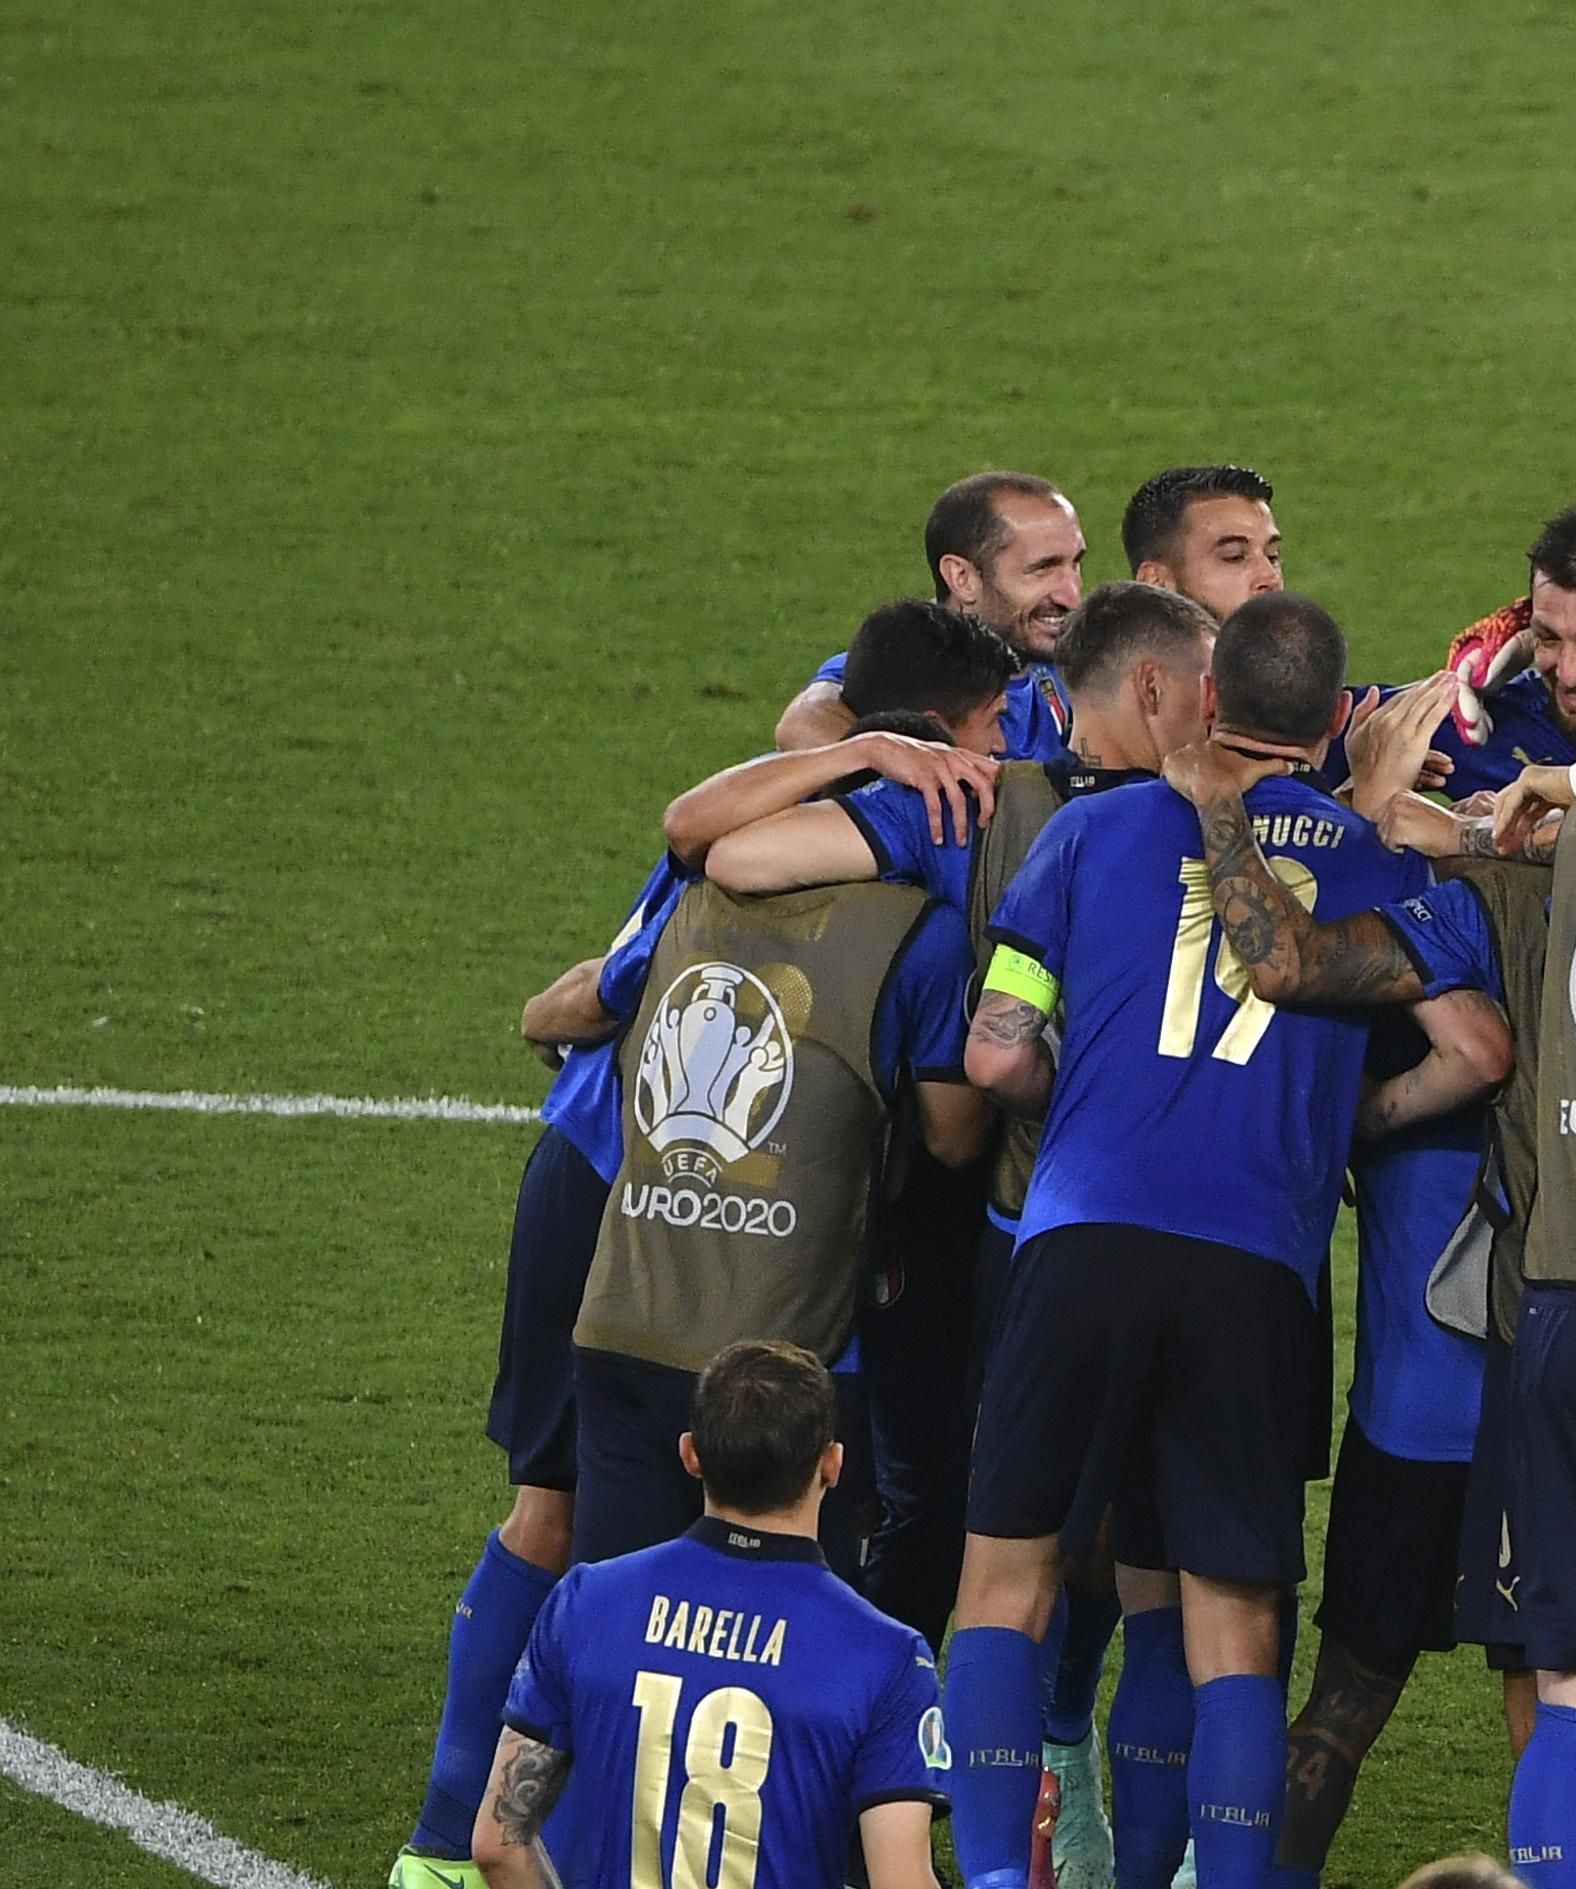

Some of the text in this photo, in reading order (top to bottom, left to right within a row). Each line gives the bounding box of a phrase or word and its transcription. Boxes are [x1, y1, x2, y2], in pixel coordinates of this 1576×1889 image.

[663, 1153, 720, 1184] UEFA
[621, 1181, 797, 1238] URO2020
[645, 1594, 788, 1667] BARELLA
[969, 1748, 1040, 1768] ITALIA
[1115, 1743, 1187, 1767] ITALIA
[630, 1670, 774, 1889] 18
[1200, 1803, 1271, 1827] ITALIA
